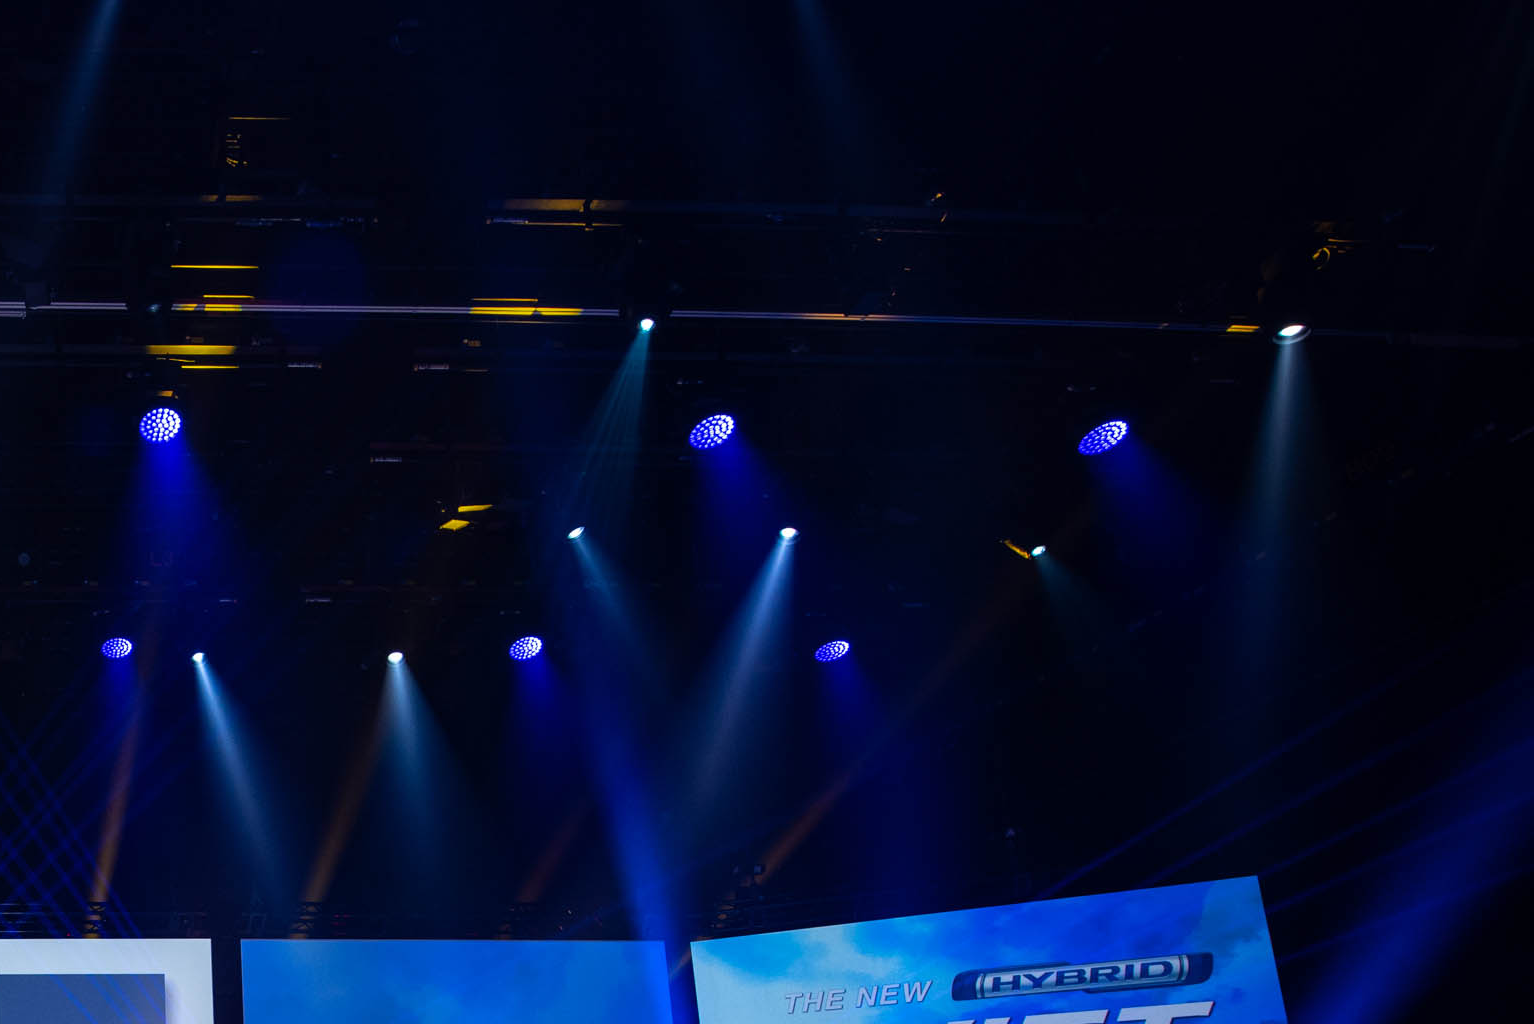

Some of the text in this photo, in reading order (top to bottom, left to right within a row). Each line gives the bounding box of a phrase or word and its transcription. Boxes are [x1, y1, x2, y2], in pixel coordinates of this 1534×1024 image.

[990, 960, 1175, 994] HYBRID
[785, 980, 933, 1015] THE NEW
